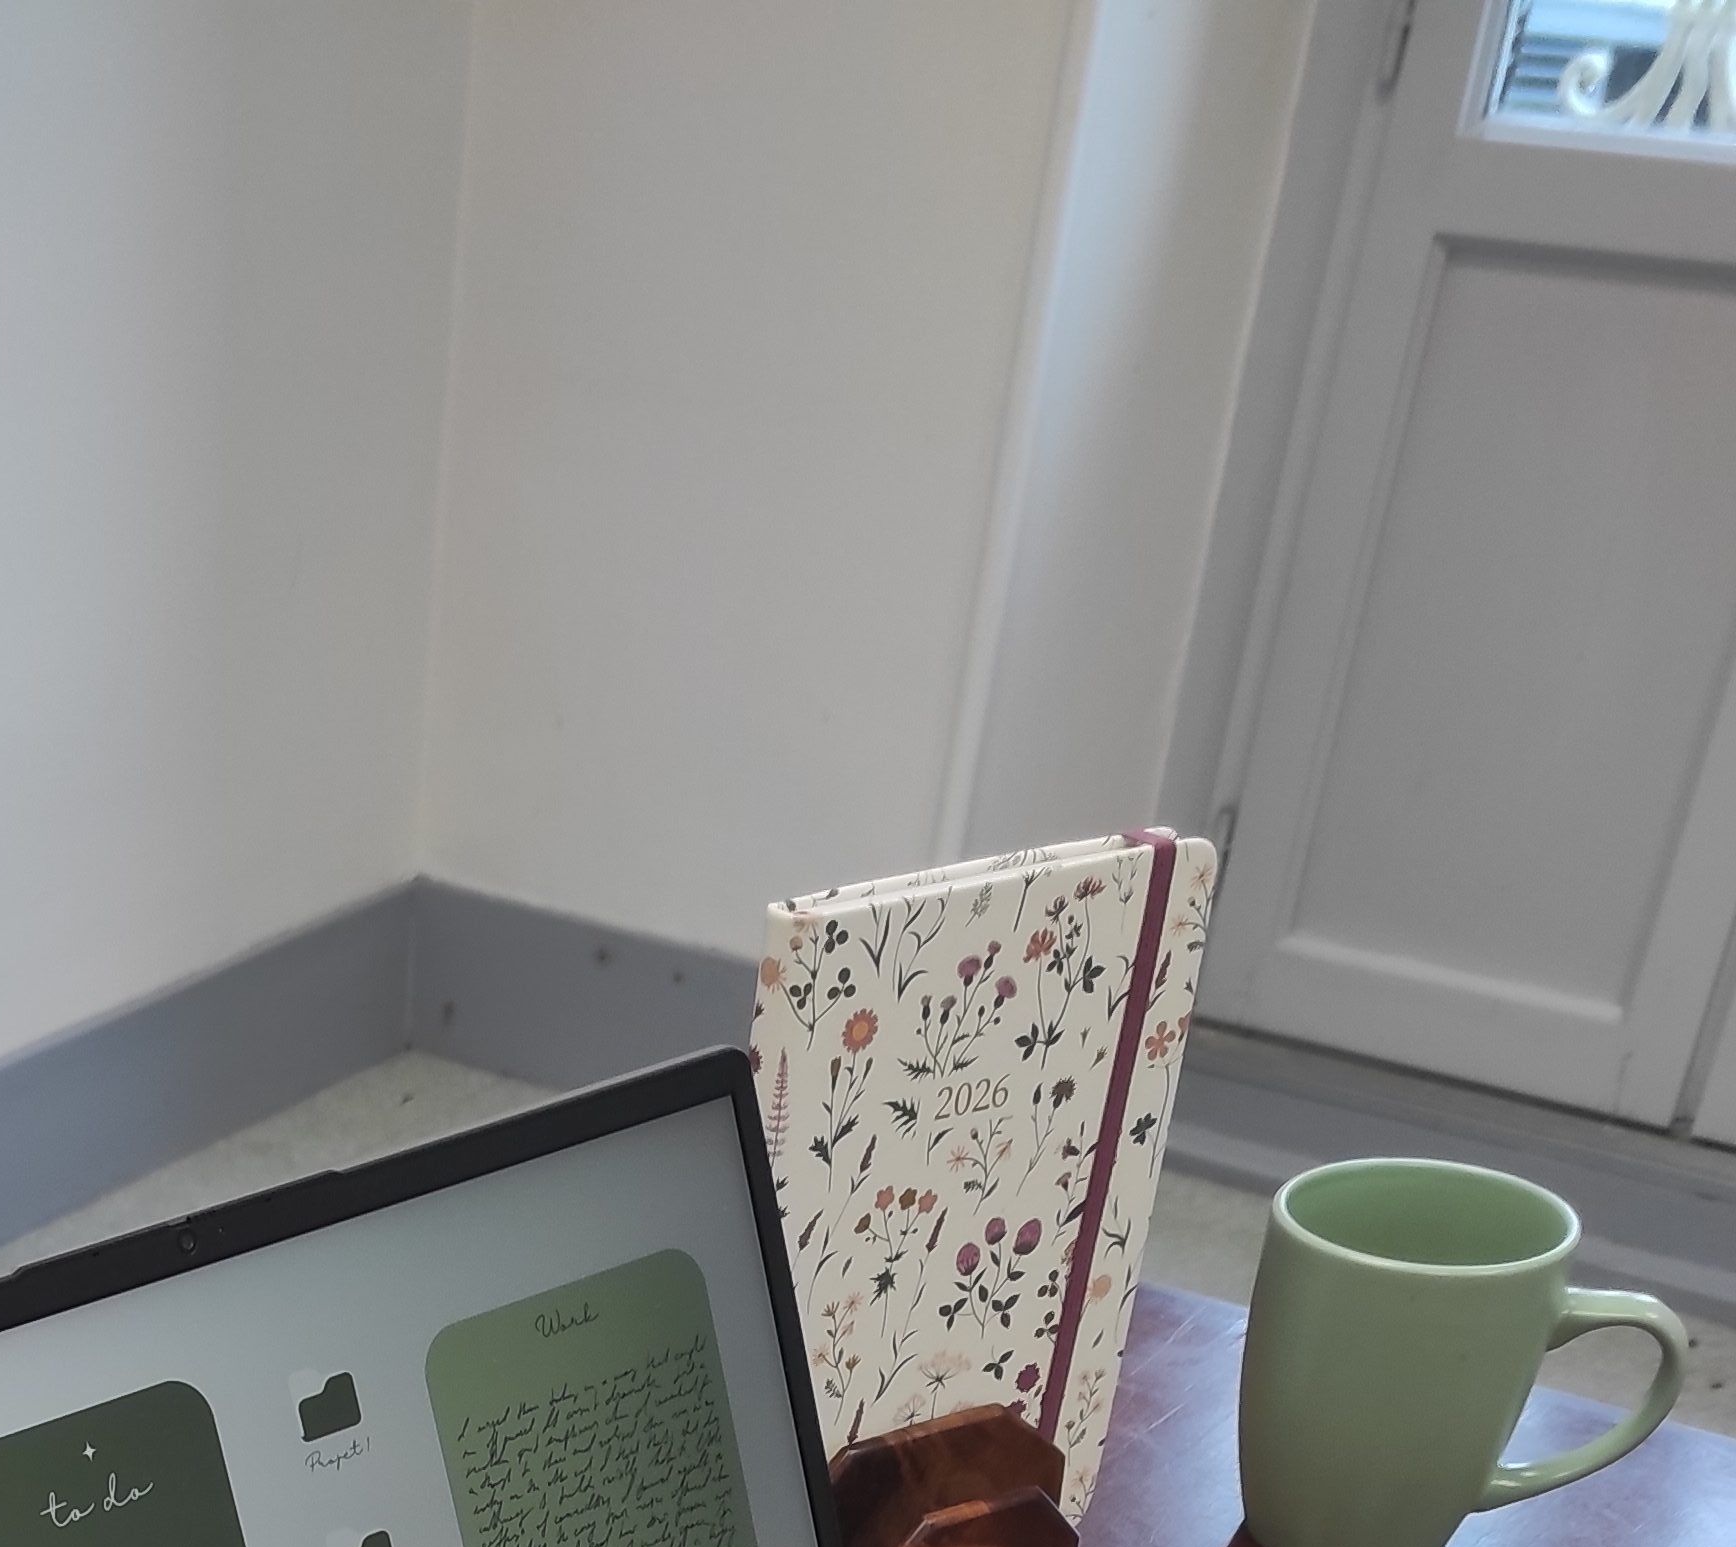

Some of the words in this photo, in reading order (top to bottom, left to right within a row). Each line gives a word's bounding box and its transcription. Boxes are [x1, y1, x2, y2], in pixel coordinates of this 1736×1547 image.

[935, 1073, 1008, 1121] 2026
[535, 1302, 599, 1337] Work
[41, 1492, 94, 1527] to
[103, 1472, 154, 1511] do
